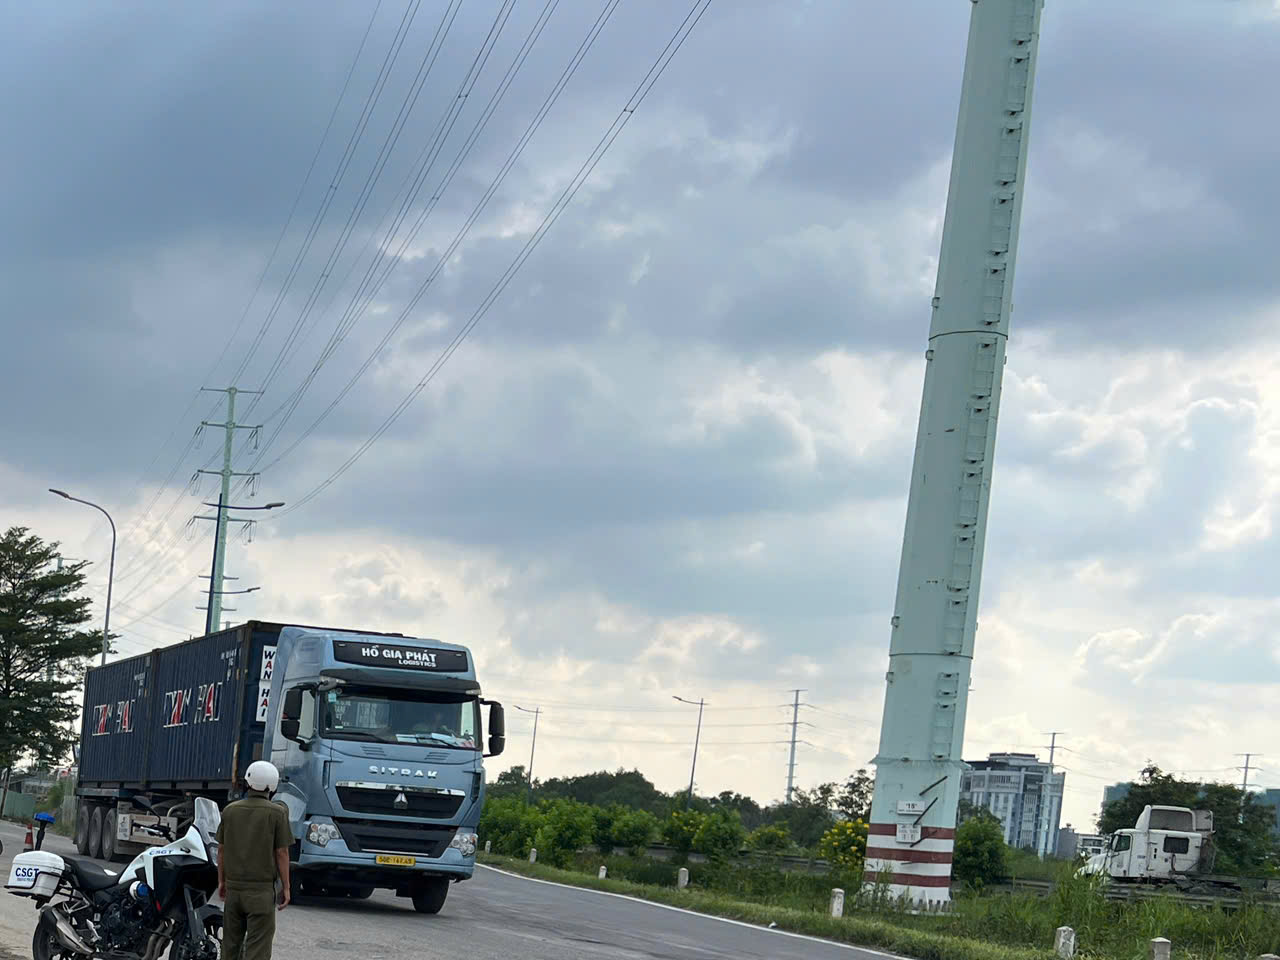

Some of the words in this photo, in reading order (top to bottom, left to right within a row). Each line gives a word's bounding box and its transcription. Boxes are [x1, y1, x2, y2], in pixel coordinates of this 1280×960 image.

[361, 644, 380, 657] HỒ
[382, 648, 402, 660] GIA
[405, 649, 437, 663] PHÁT
[263, 650, 276, 680] WAN
[398, 659, 437, 668] LOGISTICS
[260, 688, 271, 718] HAI
[368, 765, 438, 779] SITRAK
